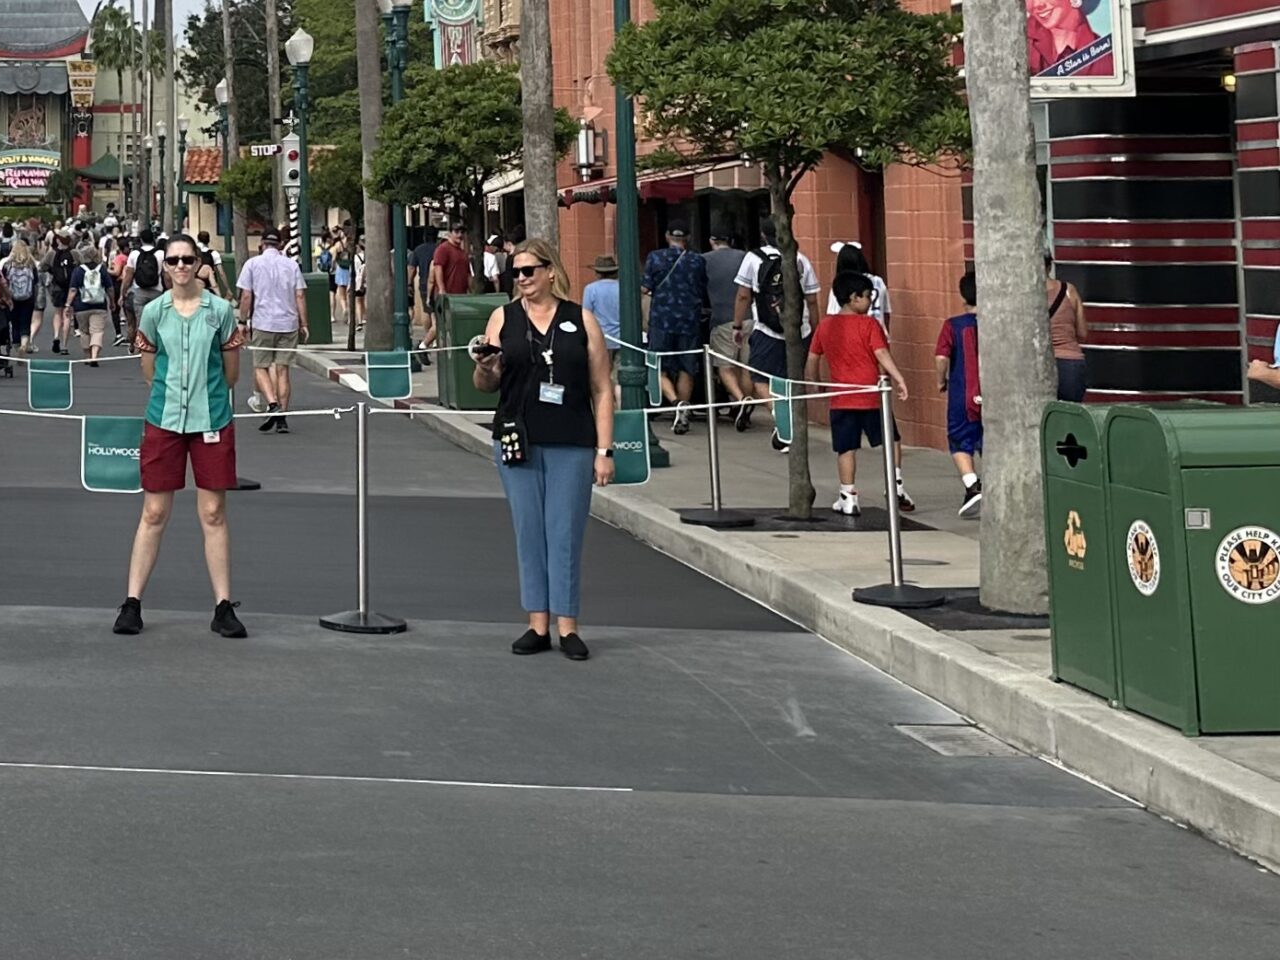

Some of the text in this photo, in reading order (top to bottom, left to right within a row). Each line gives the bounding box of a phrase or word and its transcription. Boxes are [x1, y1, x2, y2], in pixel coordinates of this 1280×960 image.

[1056, 38, 1111, 76] A Star is Born!
[250, 144, 278, 157] STOP
[5, 168, 52, 178] RUNAWAY
[1219, 532, 1243, 563] PLEASE
[1245, 530, 1270, 540] HELP
[1222, 573, 1240, 594] OUR
[1241, 590, 1263, 600] CITY
